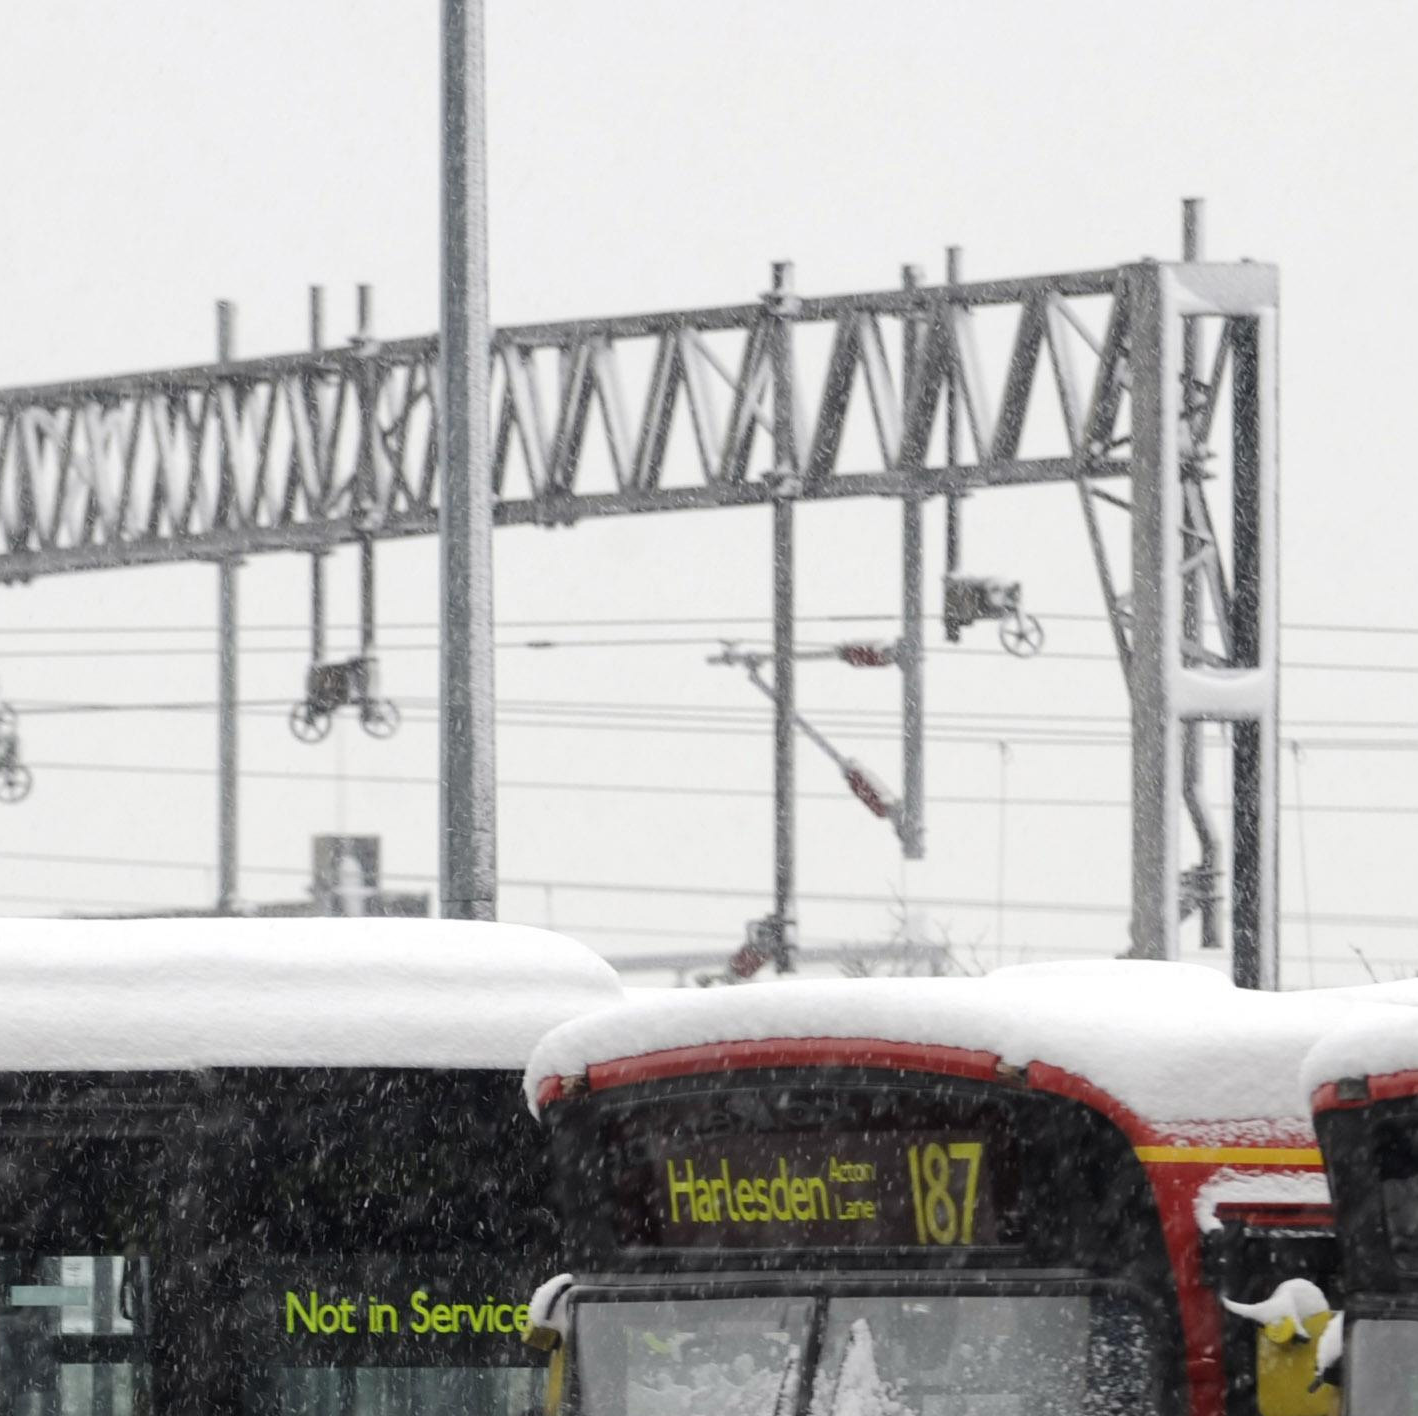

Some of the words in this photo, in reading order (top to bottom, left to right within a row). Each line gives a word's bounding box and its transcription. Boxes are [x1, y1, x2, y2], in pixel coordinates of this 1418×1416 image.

[667, 1156, 829, 1223] Harlesden
[830, 1155, 876, 1183] Acton
[835, 1193, 876, 1221] Lane
[908, 1142, 982, 1245] 187
[285, 1290, 356, 1334] Not
[369, 1296, 398, 1333] in
[410, 1289, 530, 1334] Service
